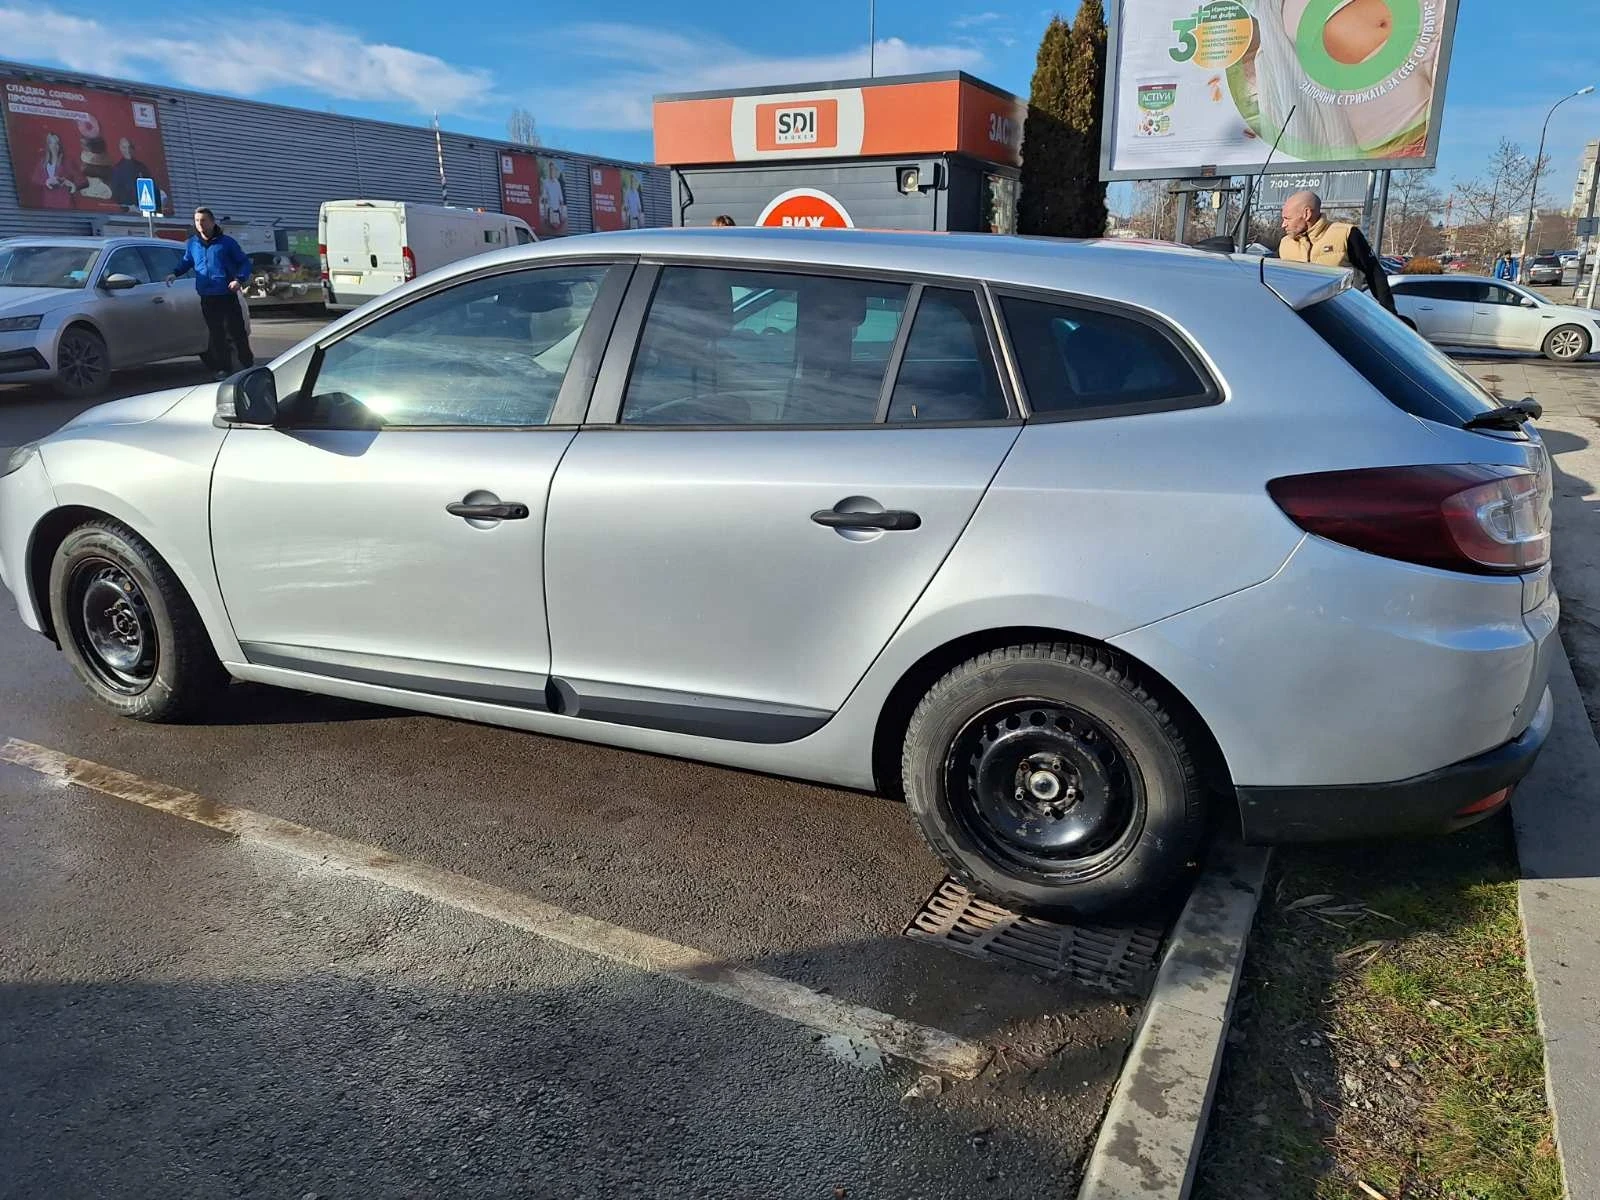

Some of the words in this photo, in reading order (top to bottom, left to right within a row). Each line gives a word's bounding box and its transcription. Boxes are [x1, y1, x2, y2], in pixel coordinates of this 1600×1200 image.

[1300, 80, 1336, 105] ЗАПОЧНИ
[1337, 94, 1343, 105] С
[1344, 86, 1387, 105] ГРИЖАТА
[1386, 77, 1400, 90] ЗА
[1398, 58, 1418, 80] СЕБЕ
[1414, 46, 1427, 60] СИ
[778, 111, 815, 134] SDI
[1270, 180, 1289, 188] 7:00
[1295, 179, 1320, 188] 22:00
[782, 216, 825, 228] ВИЖ
